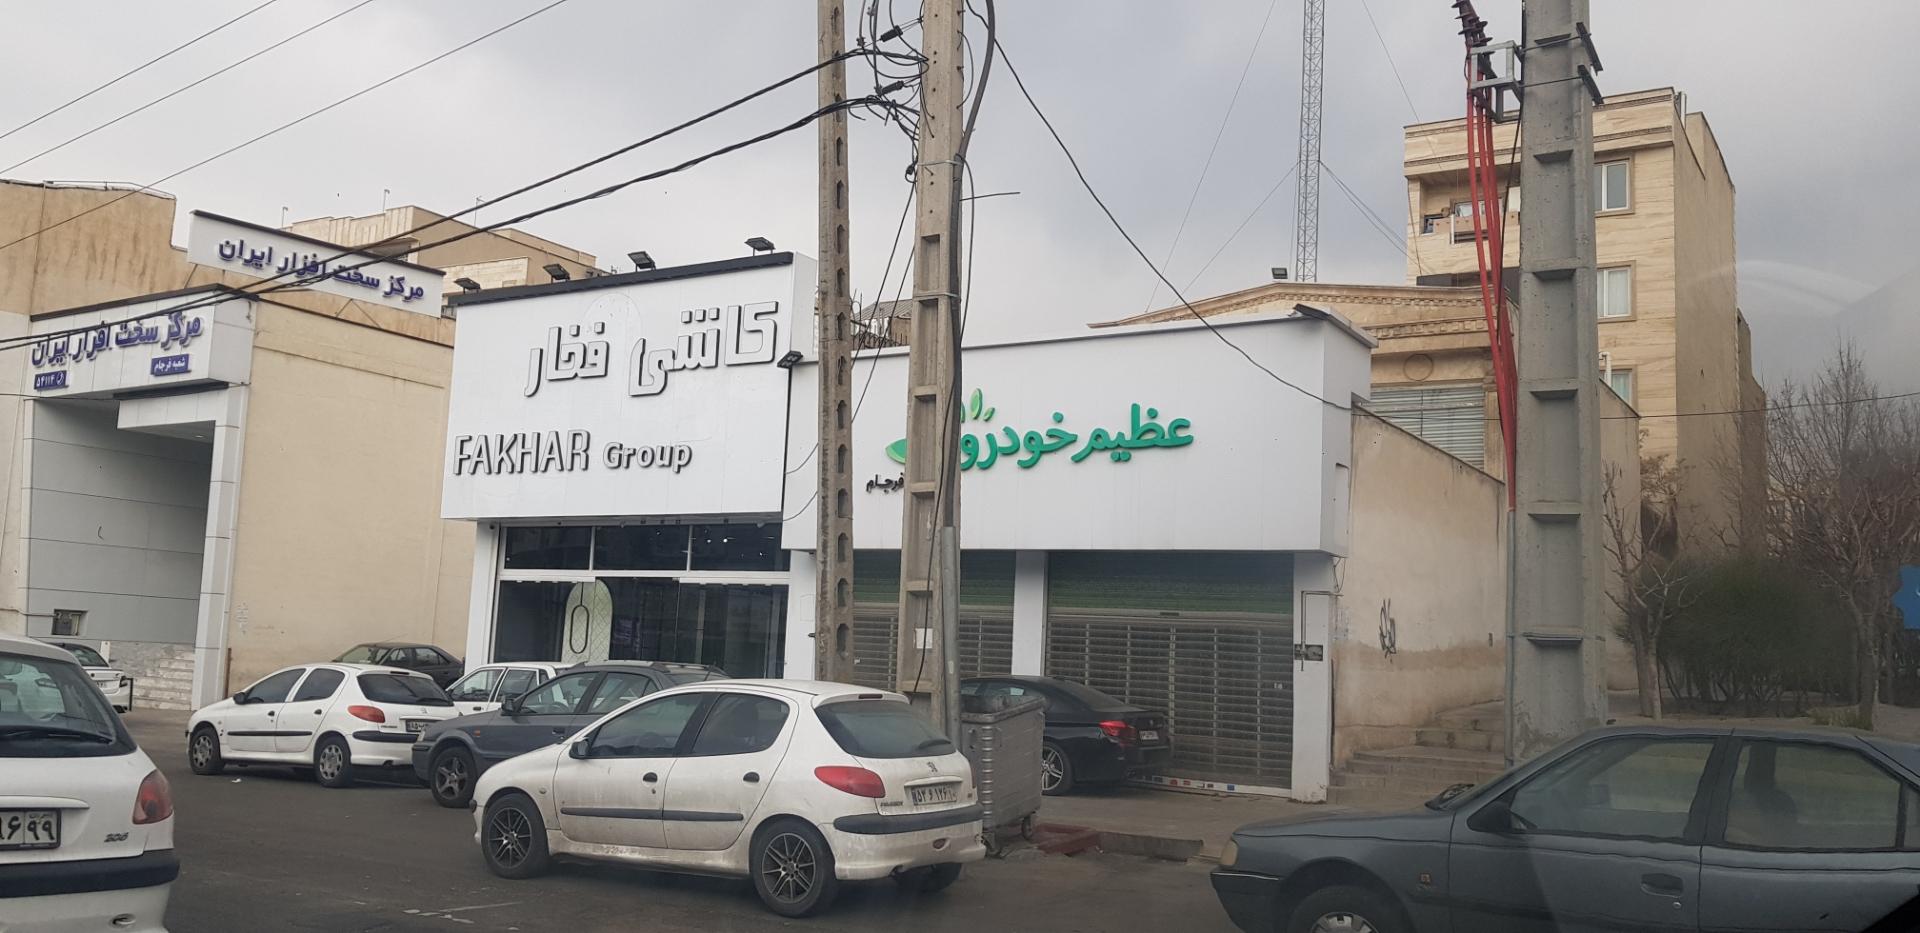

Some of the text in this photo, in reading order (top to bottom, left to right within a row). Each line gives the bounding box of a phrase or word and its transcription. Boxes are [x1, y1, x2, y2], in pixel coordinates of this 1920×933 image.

[219, 239, 424, 301] مرکز سخت افزار ایران
[114, 320, 159, 347] سخت
[160, 311, 202, 350] مرکز
[31, 334, 70, 367] ایران
[153, 356, 186, 374] شعبه فرجام
[524, 300, 779, 398] کاشی فخار
[453, 429, 693, 476] FAKHAR Group
[959, 402, 1195, 472] عظیم خودرو
[865, 471, 905, 494] فرجام
[27, 819, 55, 841] ۹۹
